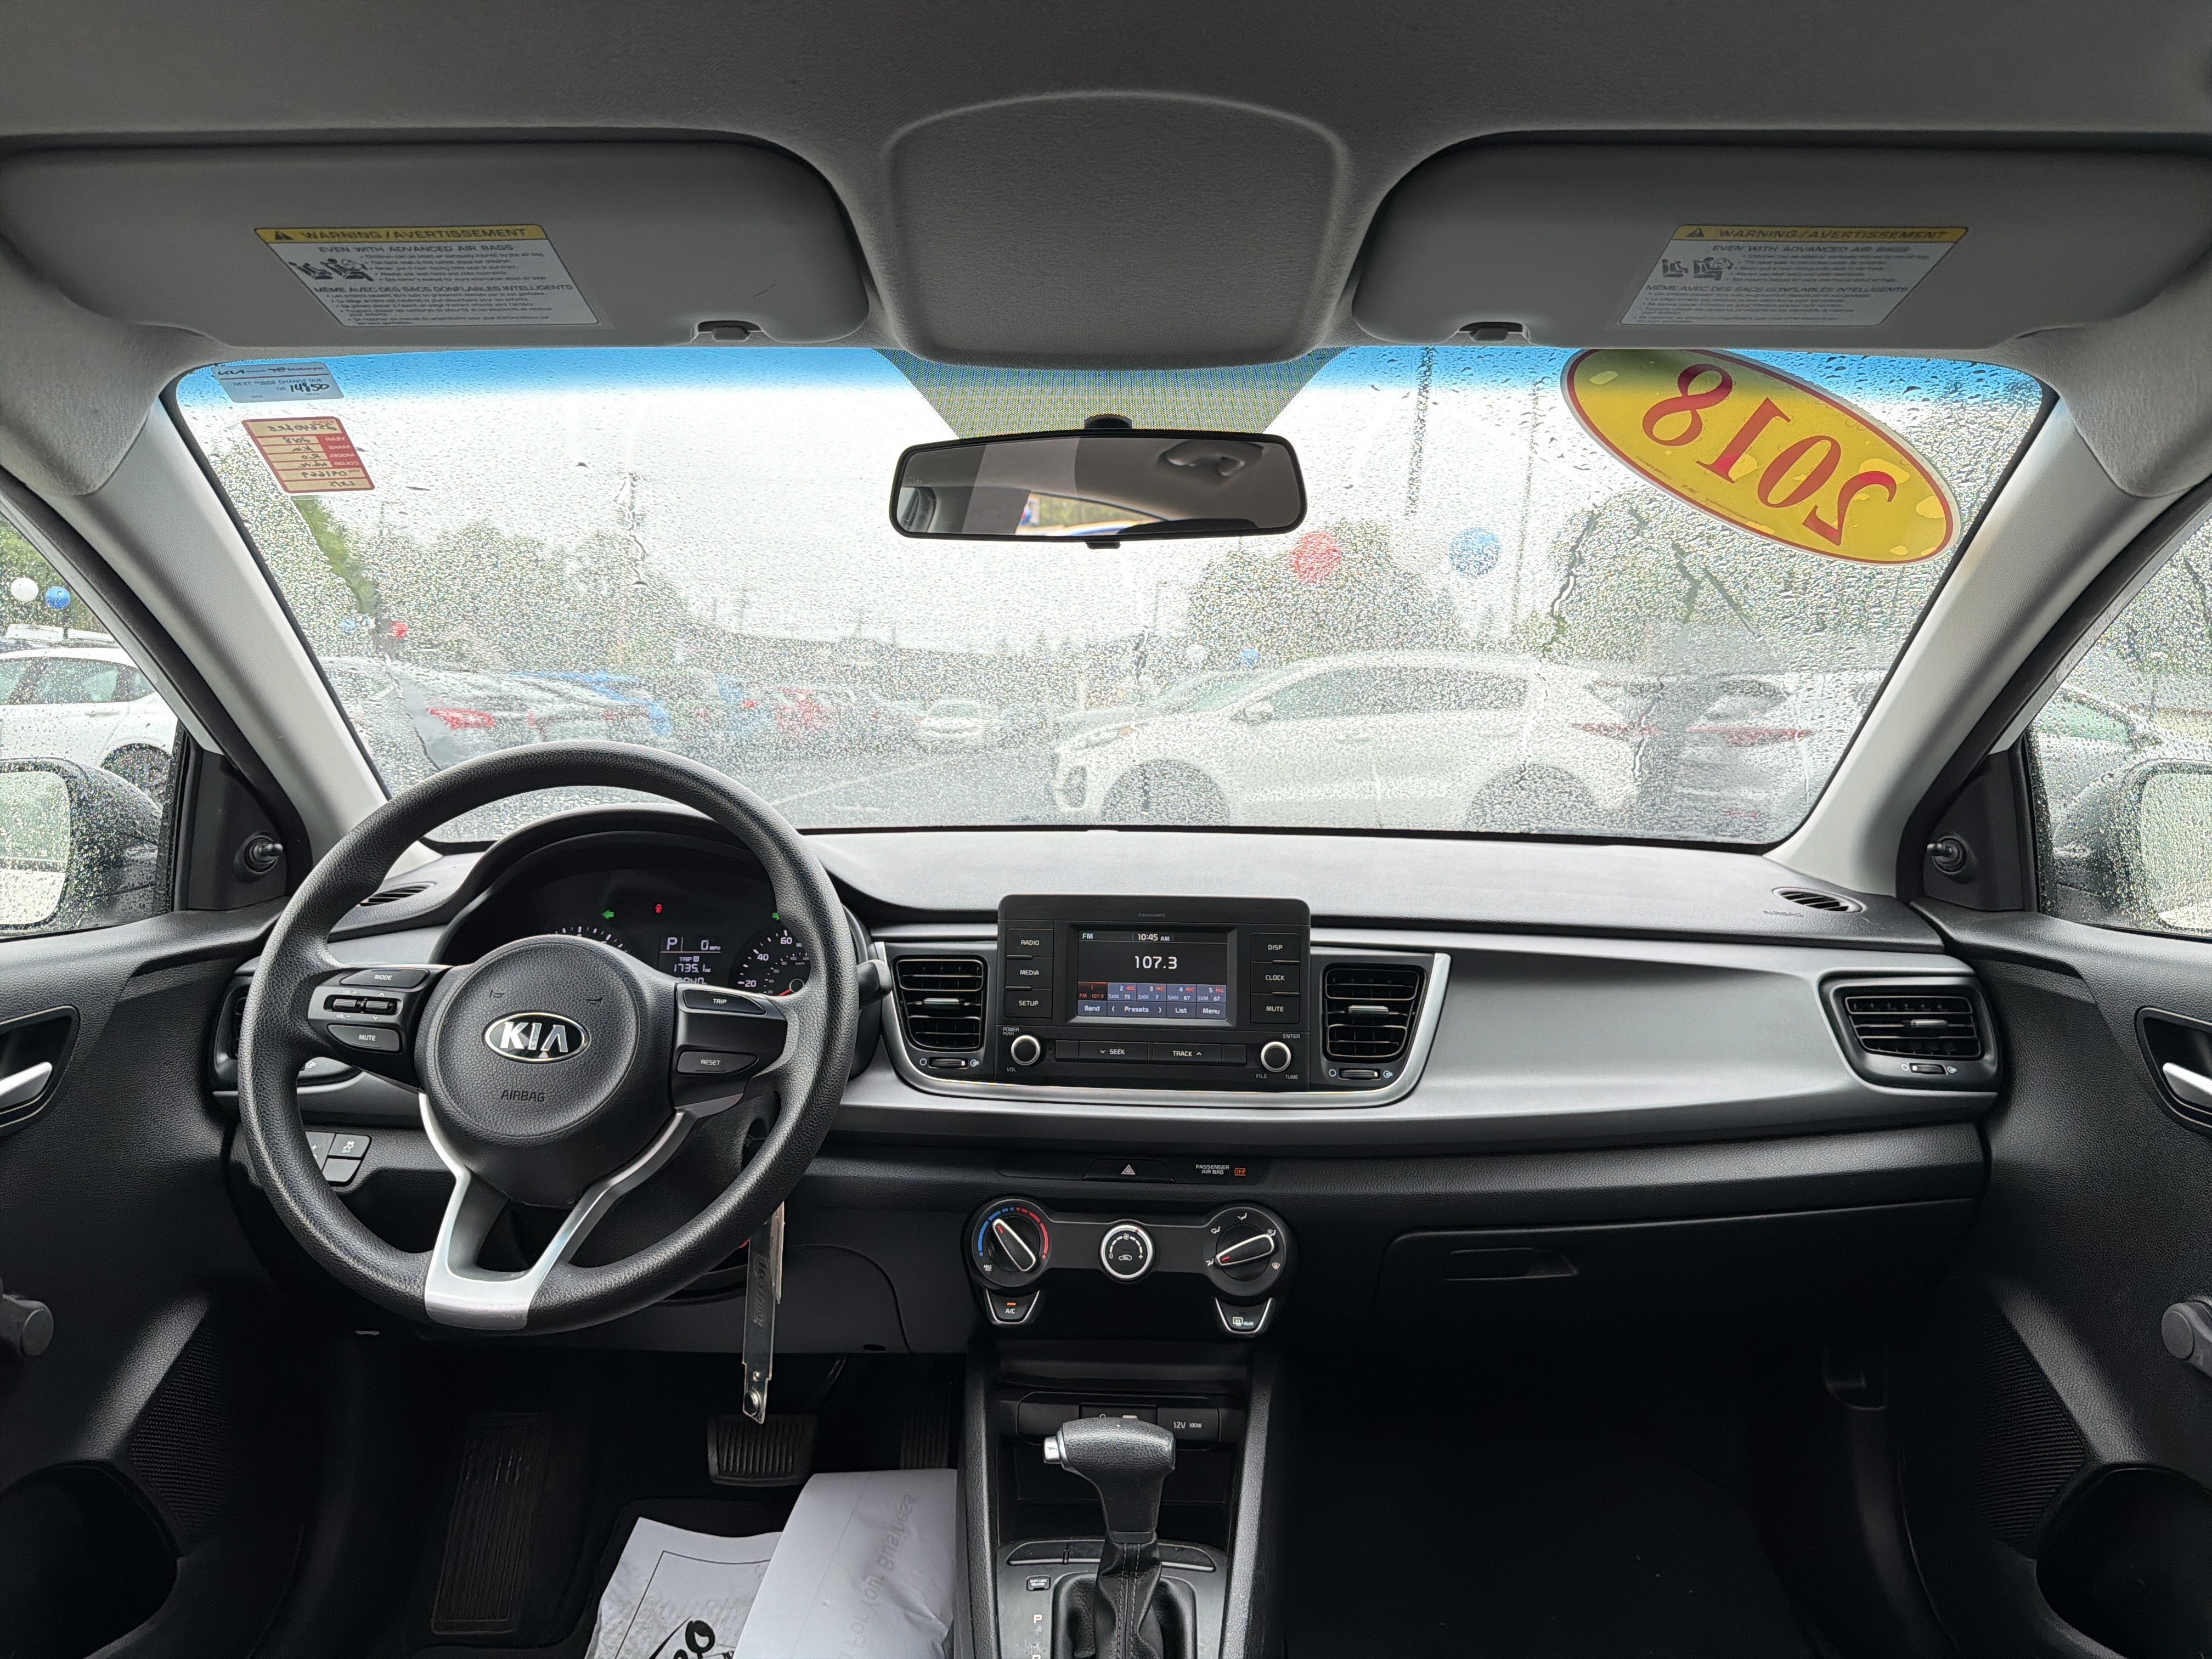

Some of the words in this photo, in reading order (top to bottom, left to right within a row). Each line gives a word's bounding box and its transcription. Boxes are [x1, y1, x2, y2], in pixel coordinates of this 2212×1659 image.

[290, 382, 330, 392] 14850
[667, 936, 678, 950] P
[1135, 956, 1177, 969] 107.3
[500, 1021, 568, 1053] KIA
[500, 1090, 546, 1102] AIRBAG
[1033, 1614, 1042, 1624] P
